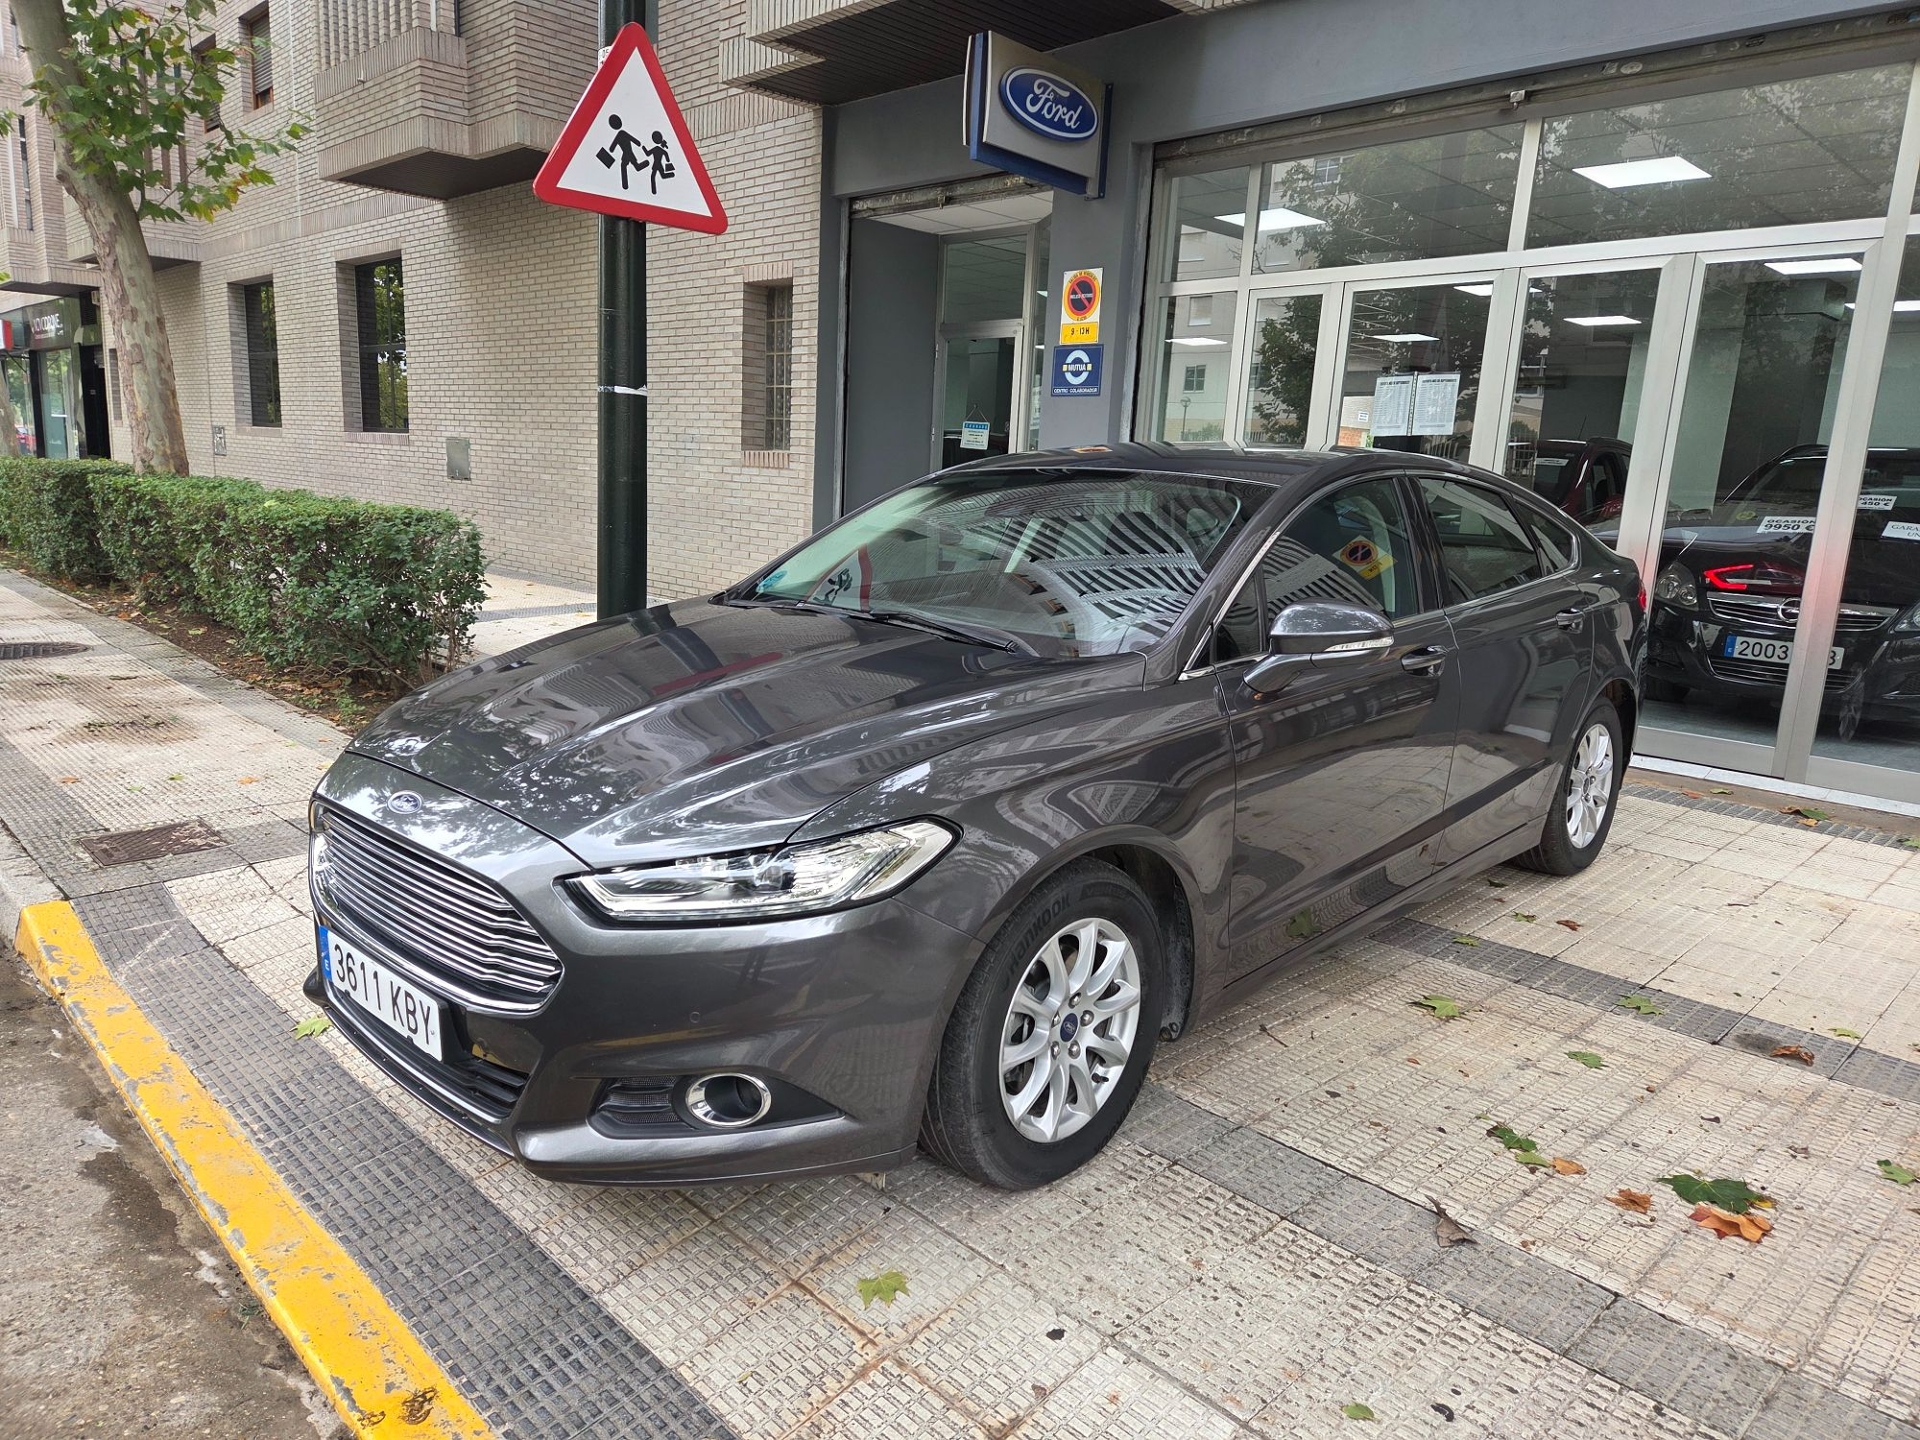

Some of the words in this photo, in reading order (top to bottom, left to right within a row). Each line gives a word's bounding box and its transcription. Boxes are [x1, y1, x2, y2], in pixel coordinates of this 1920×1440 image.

[1026, 78, 1082, 129] Ford
[1070, 327, 1075, 336] 9
[1068, 363, 1086, 371] MUTUA
[1764, 523, 1801, 531] 9950
[1738, 640, 1790, 660] 2003
[334, 943, 382, 1011] 3611
[390, 980, 431, 1045] KBY
